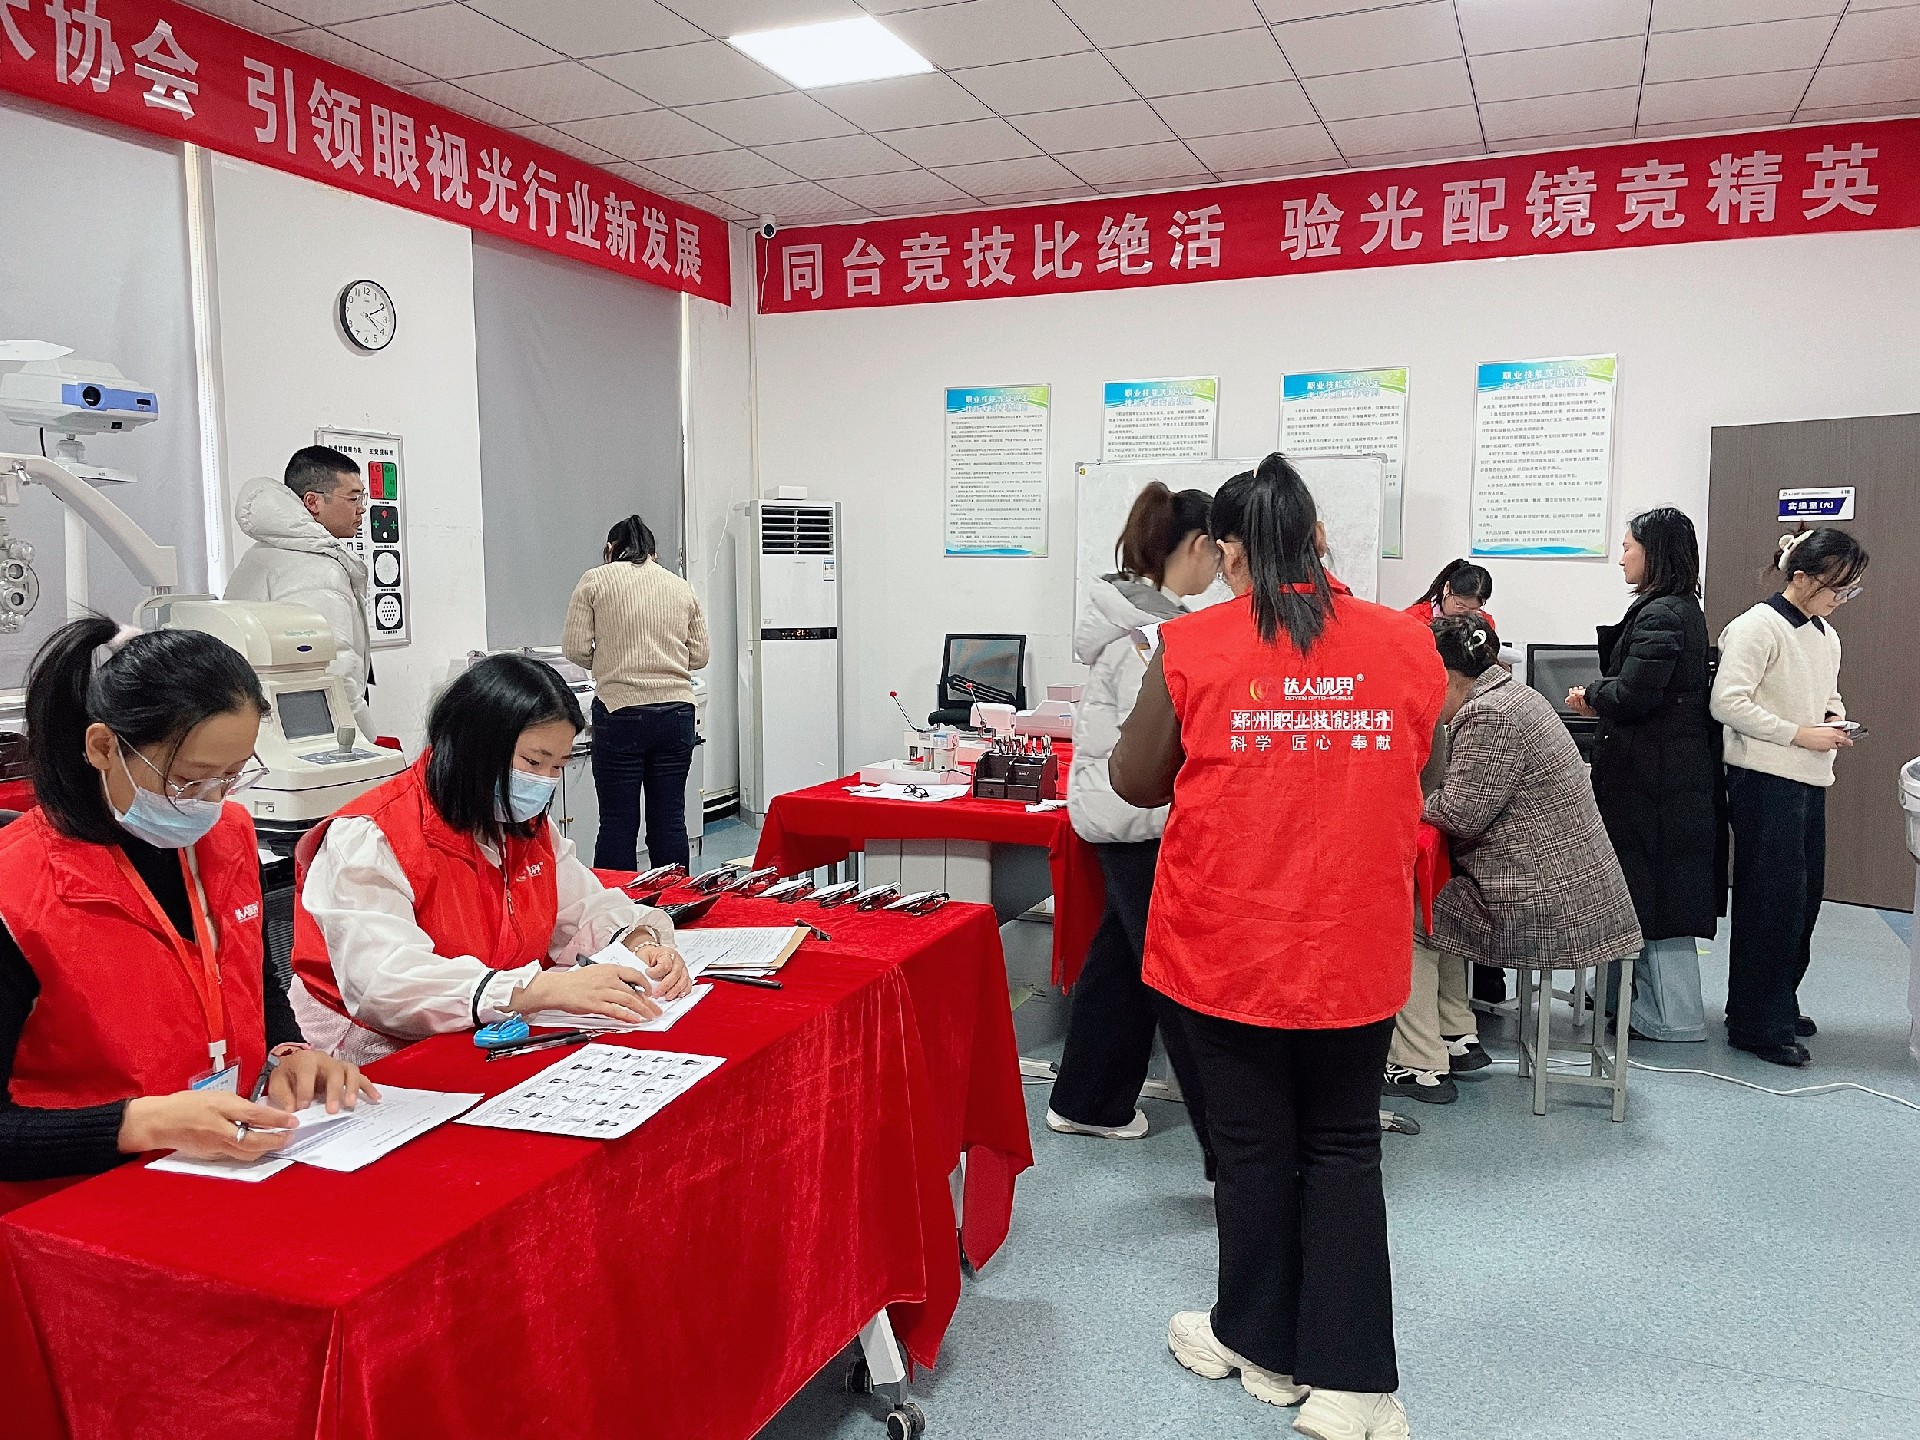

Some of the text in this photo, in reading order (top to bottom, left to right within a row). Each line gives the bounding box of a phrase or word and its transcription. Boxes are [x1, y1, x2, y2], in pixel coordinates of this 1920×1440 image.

[244, 55, 703, 286] 引领眼视光行业新发展
[781, 141, 1880, 302] 同台竞技比绝活 验光配镜竞精英
[1230, 734, 1391, 752] 科学 匠心 奉献
[1232, 710, 1391, 731] 郑州职业技能提升
